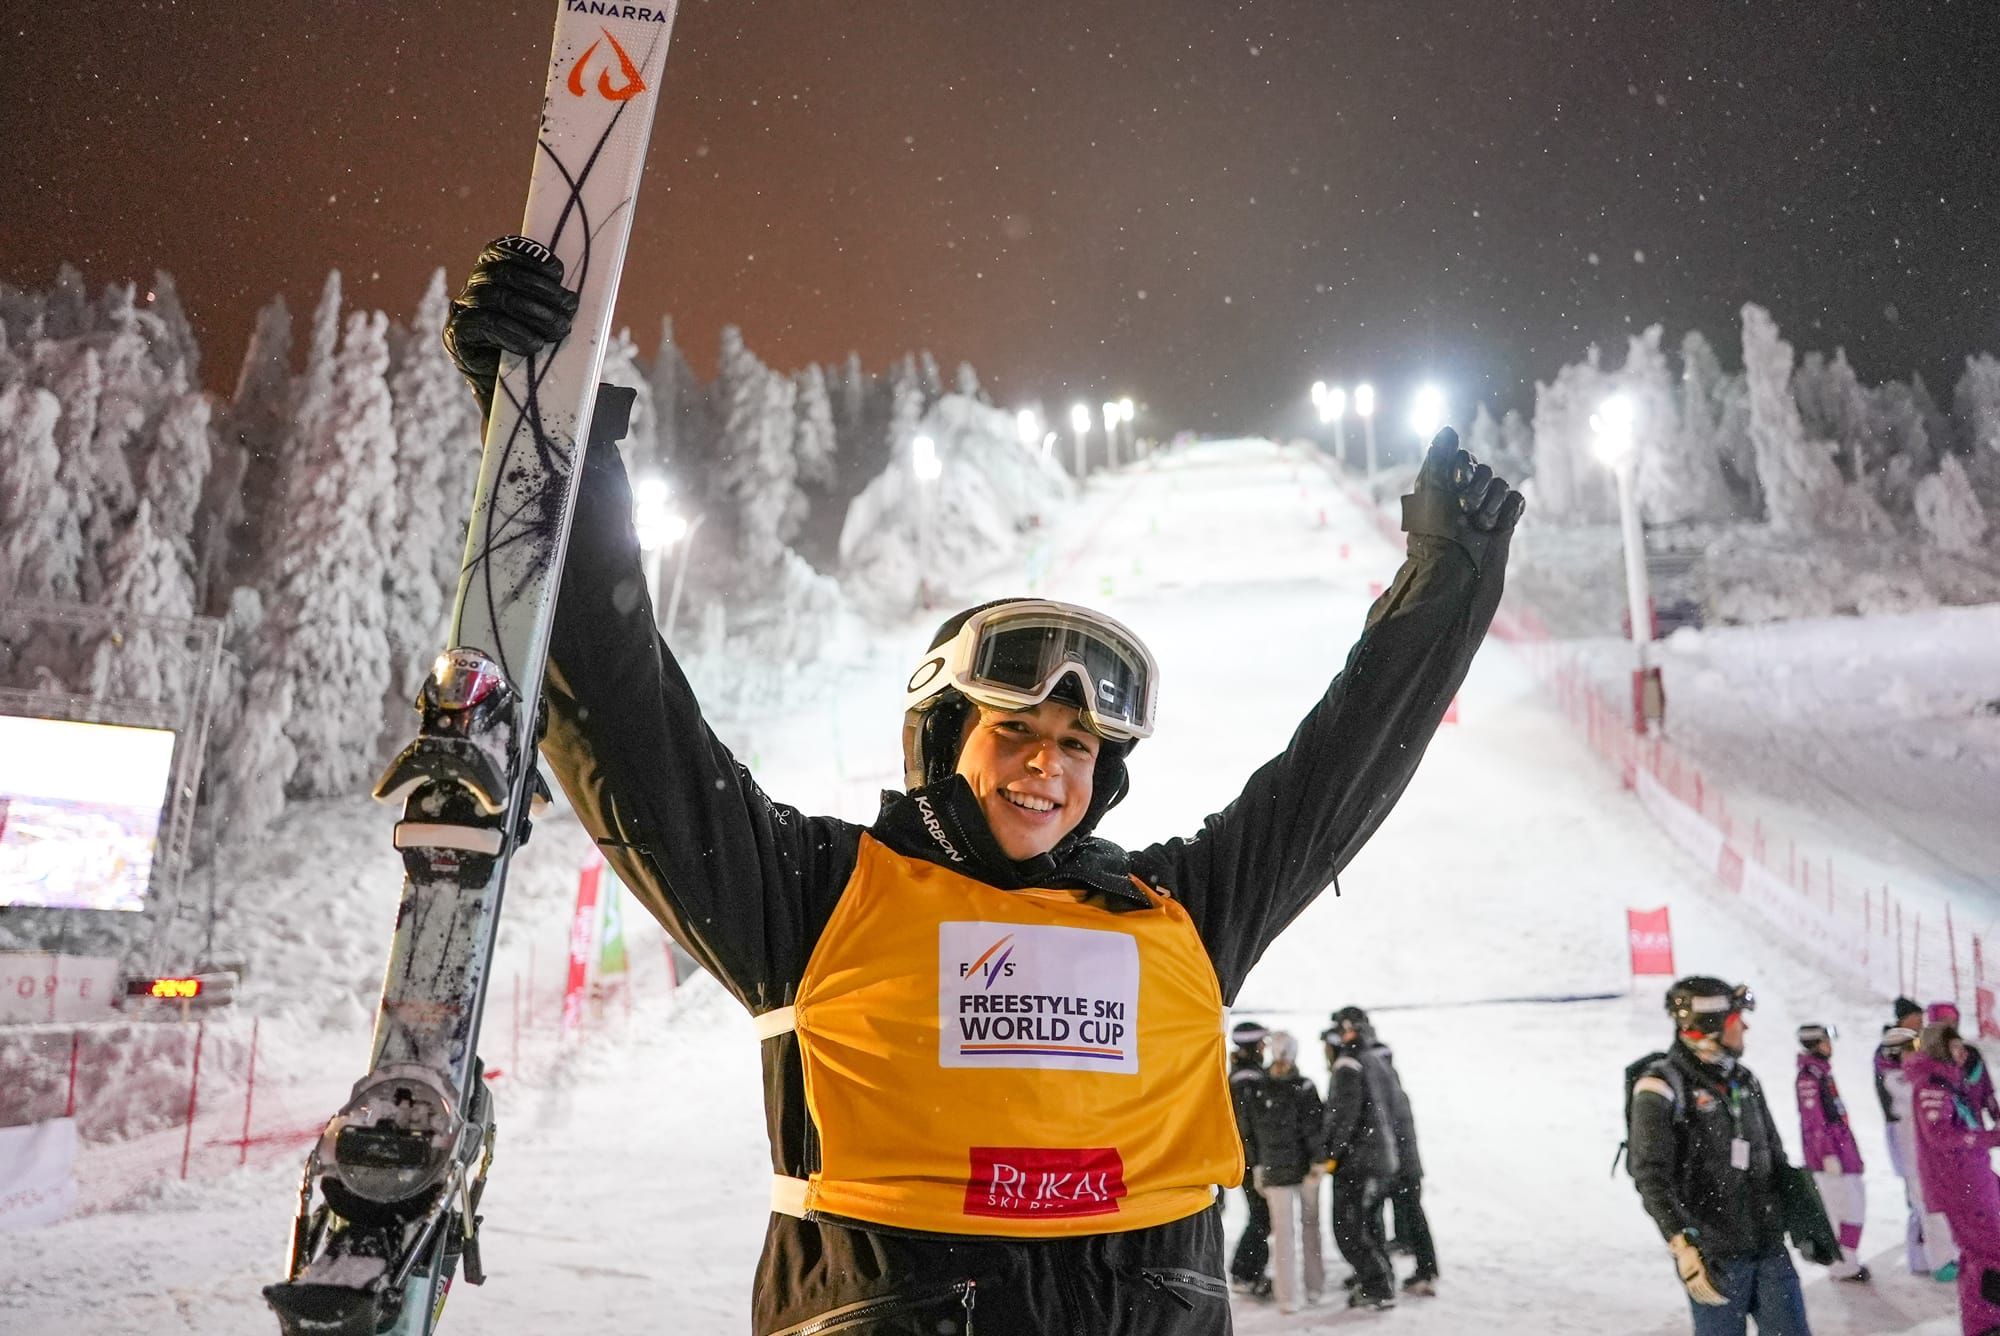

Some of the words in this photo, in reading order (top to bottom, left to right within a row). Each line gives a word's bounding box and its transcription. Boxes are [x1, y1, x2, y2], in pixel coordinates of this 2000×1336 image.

[566, 0, 666, 23] TANARRA
[914, 795, 965, 862] KARBON
[959, 962, 1016, 977] FIS
[959, 995, 1088, 1016] FREESTYLE
[1094, 1000, 1125, 1020] SKI
[959, 1017, 1070, 1041] WORLD
[1079, 1020, 1124, 1045] CUP
[989, 1163, 1108, 1202] RUKA!
